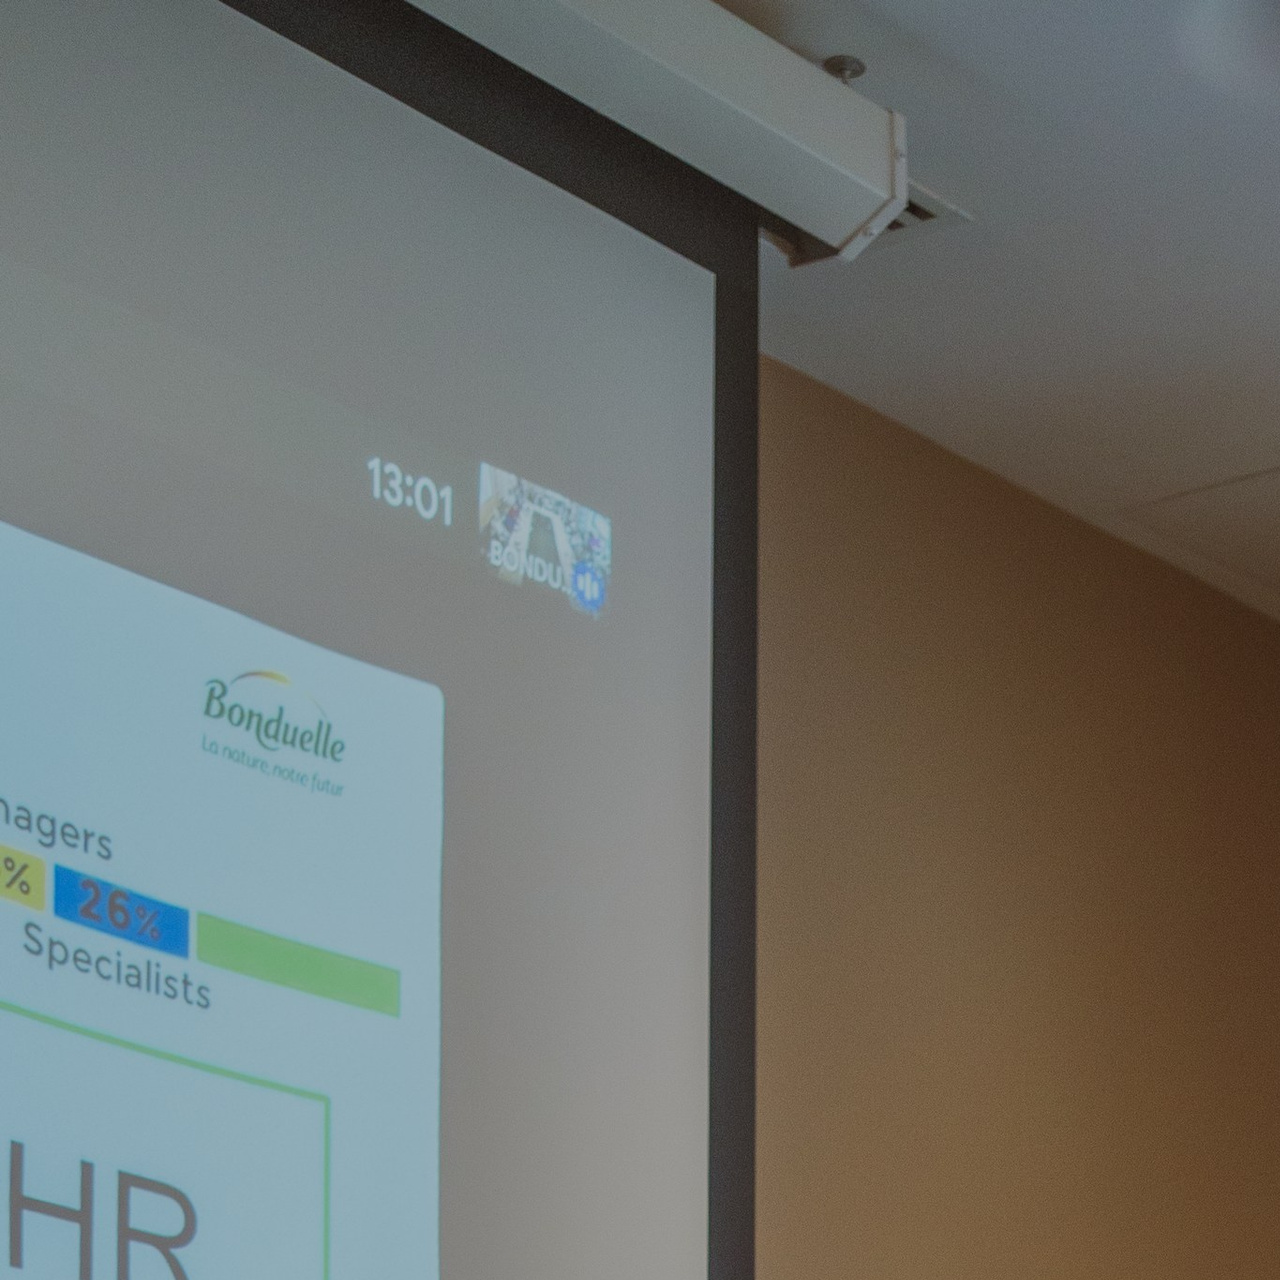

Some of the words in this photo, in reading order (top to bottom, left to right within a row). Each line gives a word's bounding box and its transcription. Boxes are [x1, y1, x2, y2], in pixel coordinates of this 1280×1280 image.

[366, 456, 453, 527] 13:01
[204, 679, 346, 763] Bonduelle
[201, 733, 219, 755] La
[272, 764, 309, 787] notre
[311, 771, 345, 797] futur
[78, 878, 161, 942] 26%
[23, 921, 211, 1010] Specialists
